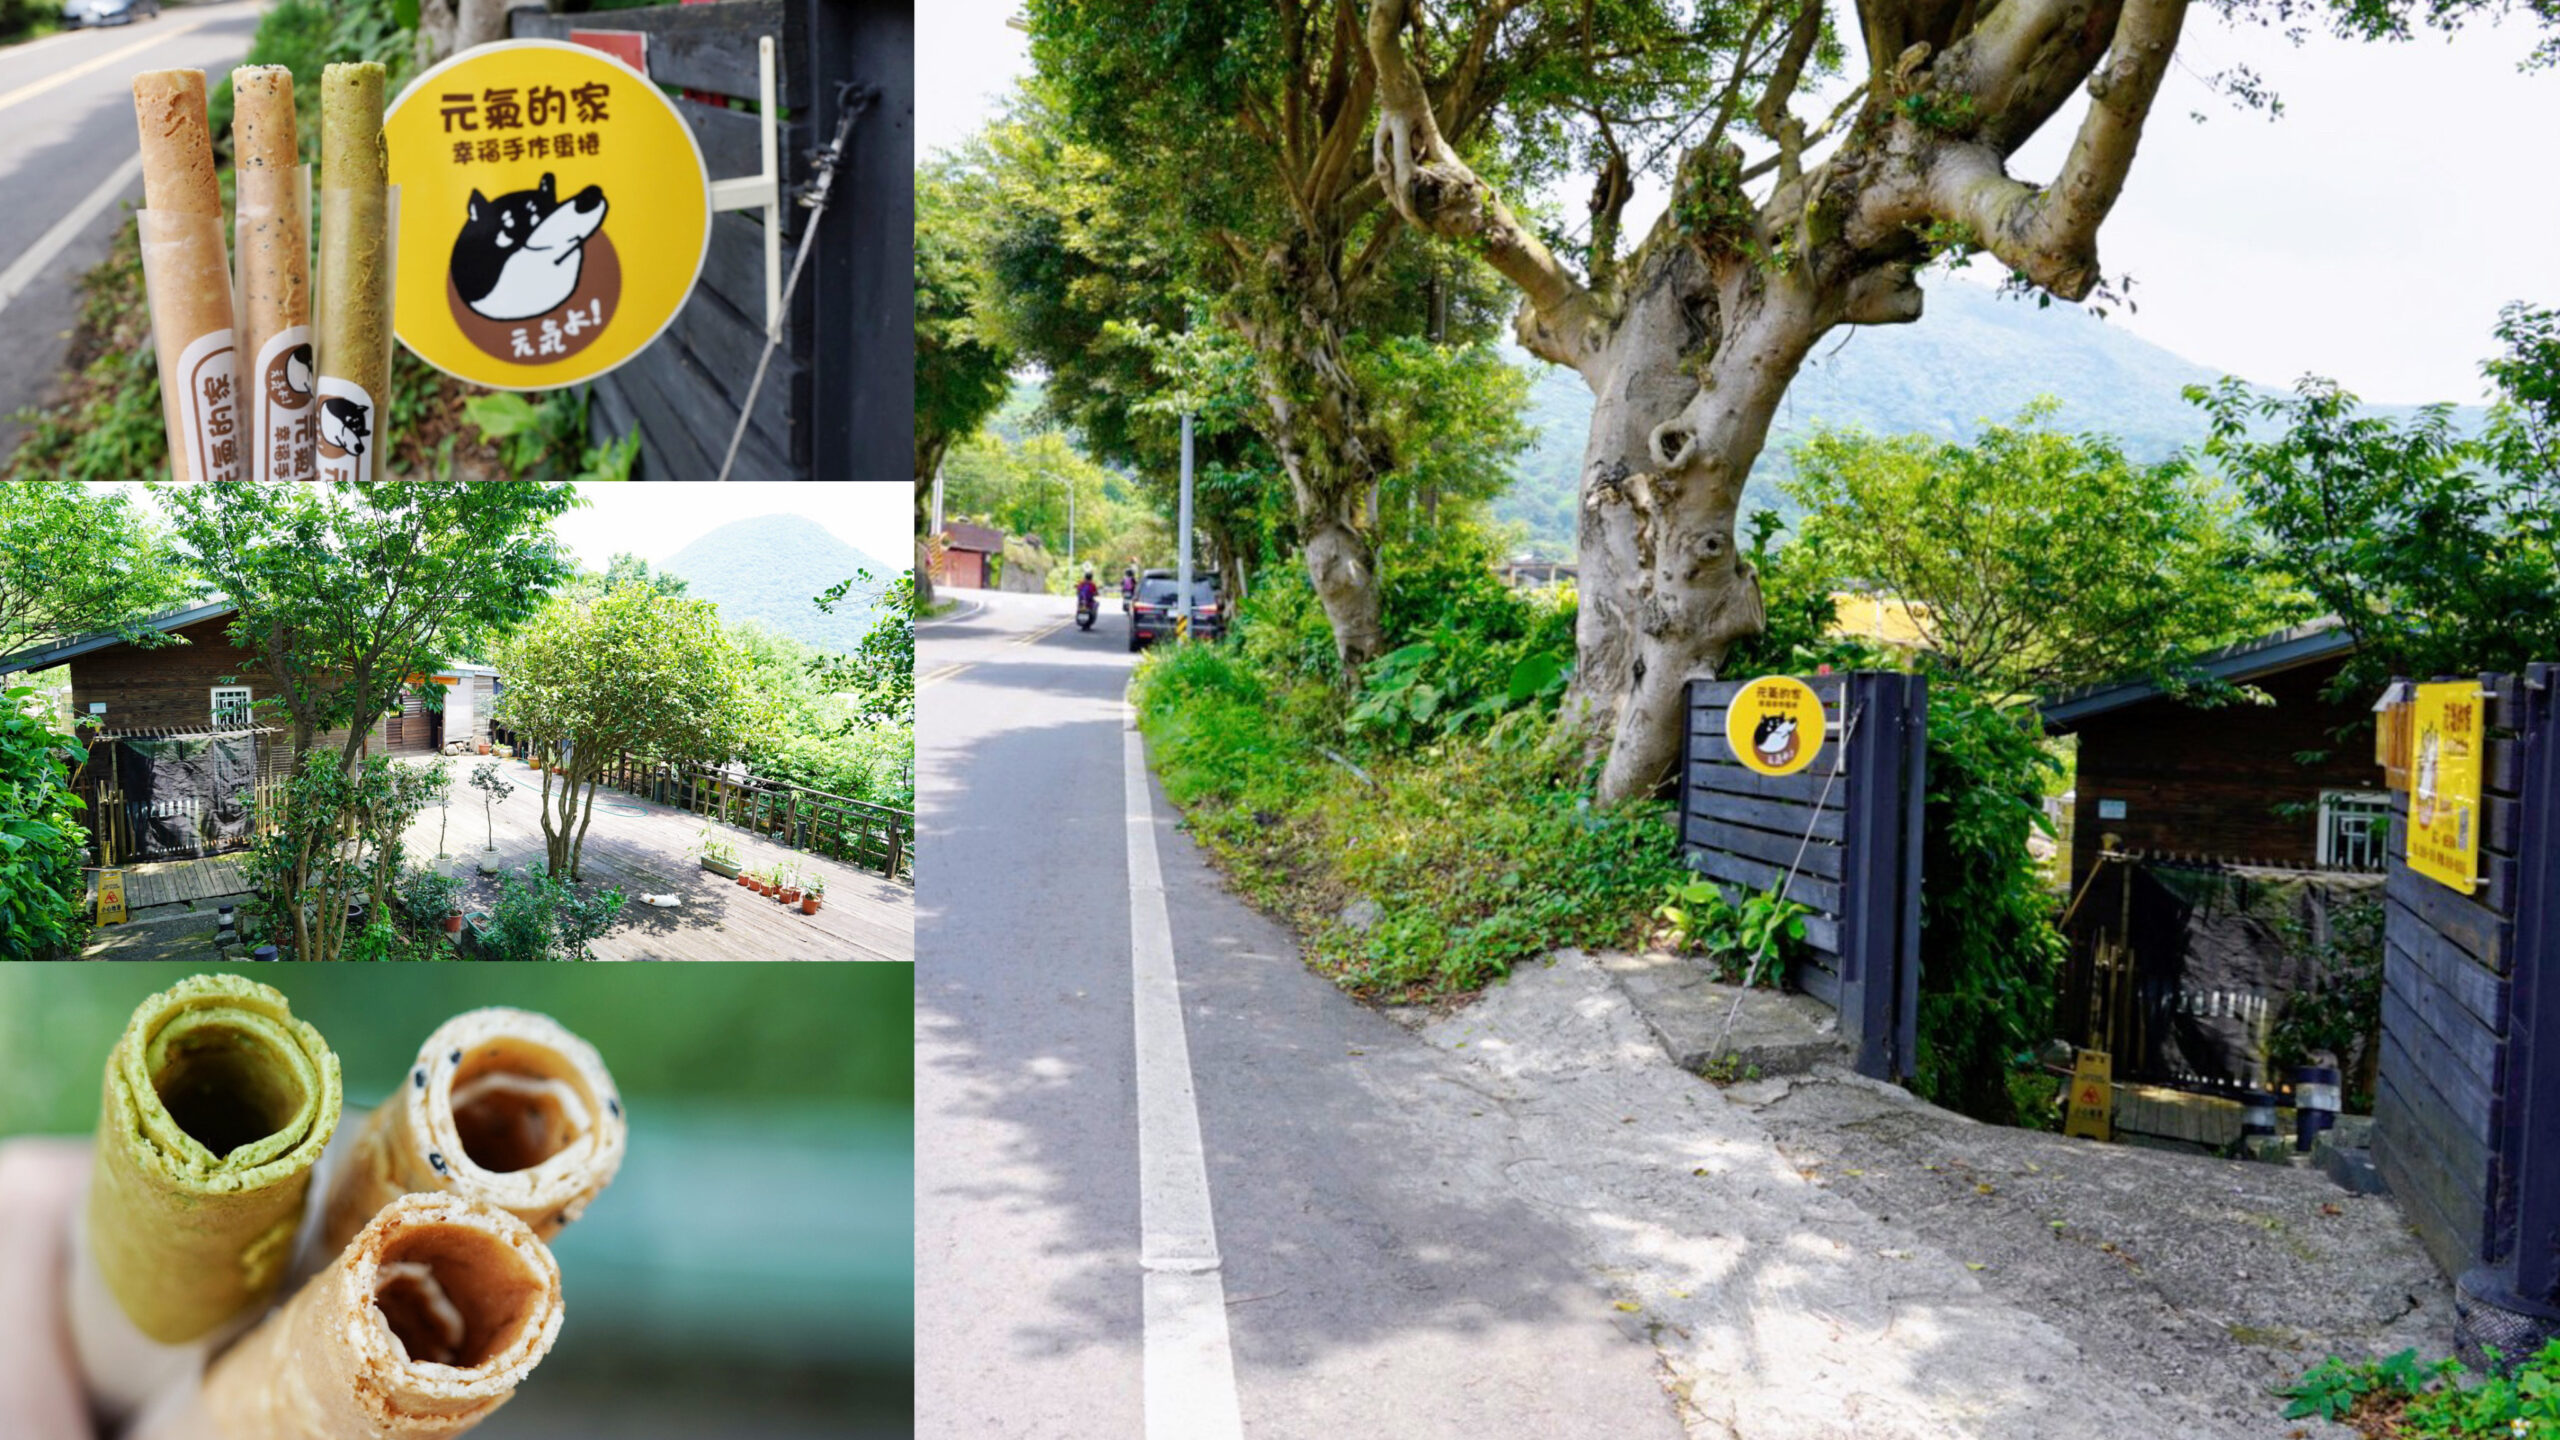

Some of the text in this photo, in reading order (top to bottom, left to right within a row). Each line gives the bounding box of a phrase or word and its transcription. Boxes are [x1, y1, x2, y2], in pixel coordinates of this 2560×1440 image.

[440, 81, 610, 133] 元氣的家
[453, 131, 600, 165] 幸福手作蛋捲
